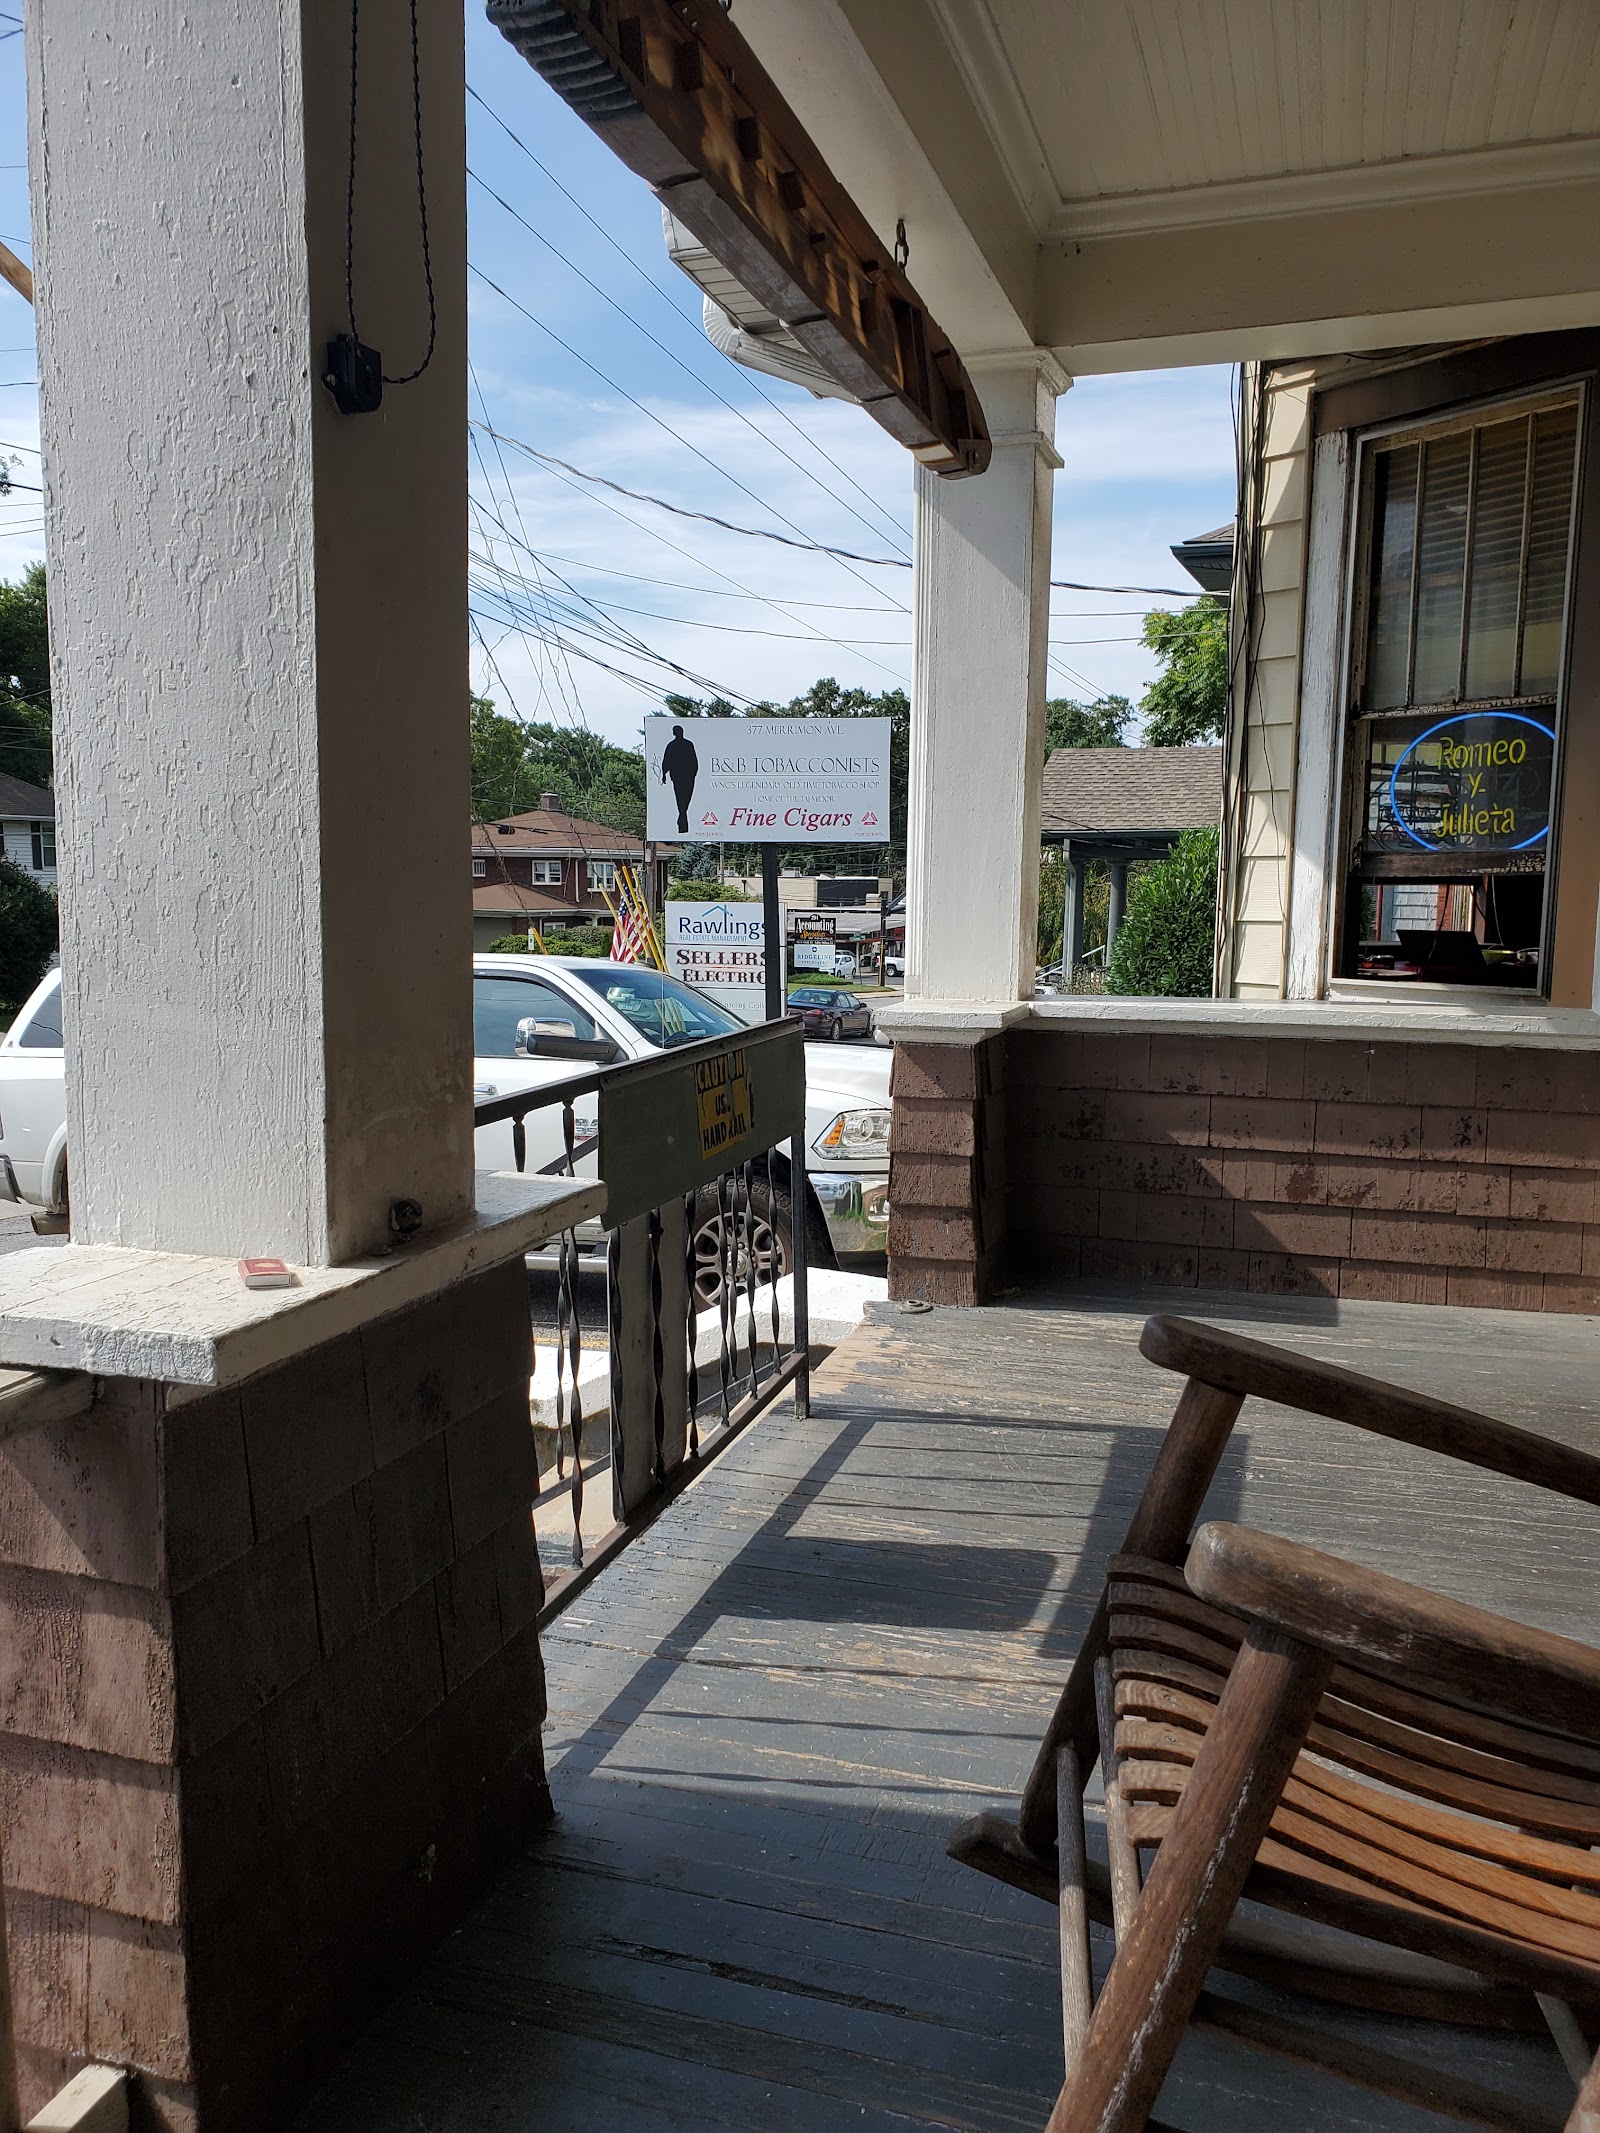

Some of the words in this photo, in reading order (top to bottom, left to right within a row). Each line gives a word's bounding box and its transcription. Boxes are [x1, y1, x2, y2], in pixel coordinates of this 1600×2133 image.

[746, 725, 763, 735] 377
[765, 725, 822, 735] MERRIMON
[1436, 736, 1527, 770] Romeo
[711, 757, 747, 773] B&B
[750, 757, 880, 773] TOBACCONISTS
[737, 781, 783, 790] LEGENDARY
[783, 781, 801, 790] OLD
[802, 781, 820, 790] TIME
[821, 781, 858, 790] TOBACCO
[859, 781, 880, 790] SHOP
[729, 808, 777, 826] Fine
[783, 807, 853, 832] Cigars
[679, 914, 765, 940] Rawlings
[795, 919, 834, 934] Accounting
[676, 949, 766, 966] SELLERS
[682, 968, 766, 985] ELECTRIC
[703, 1122, 726, 1151] HAND
